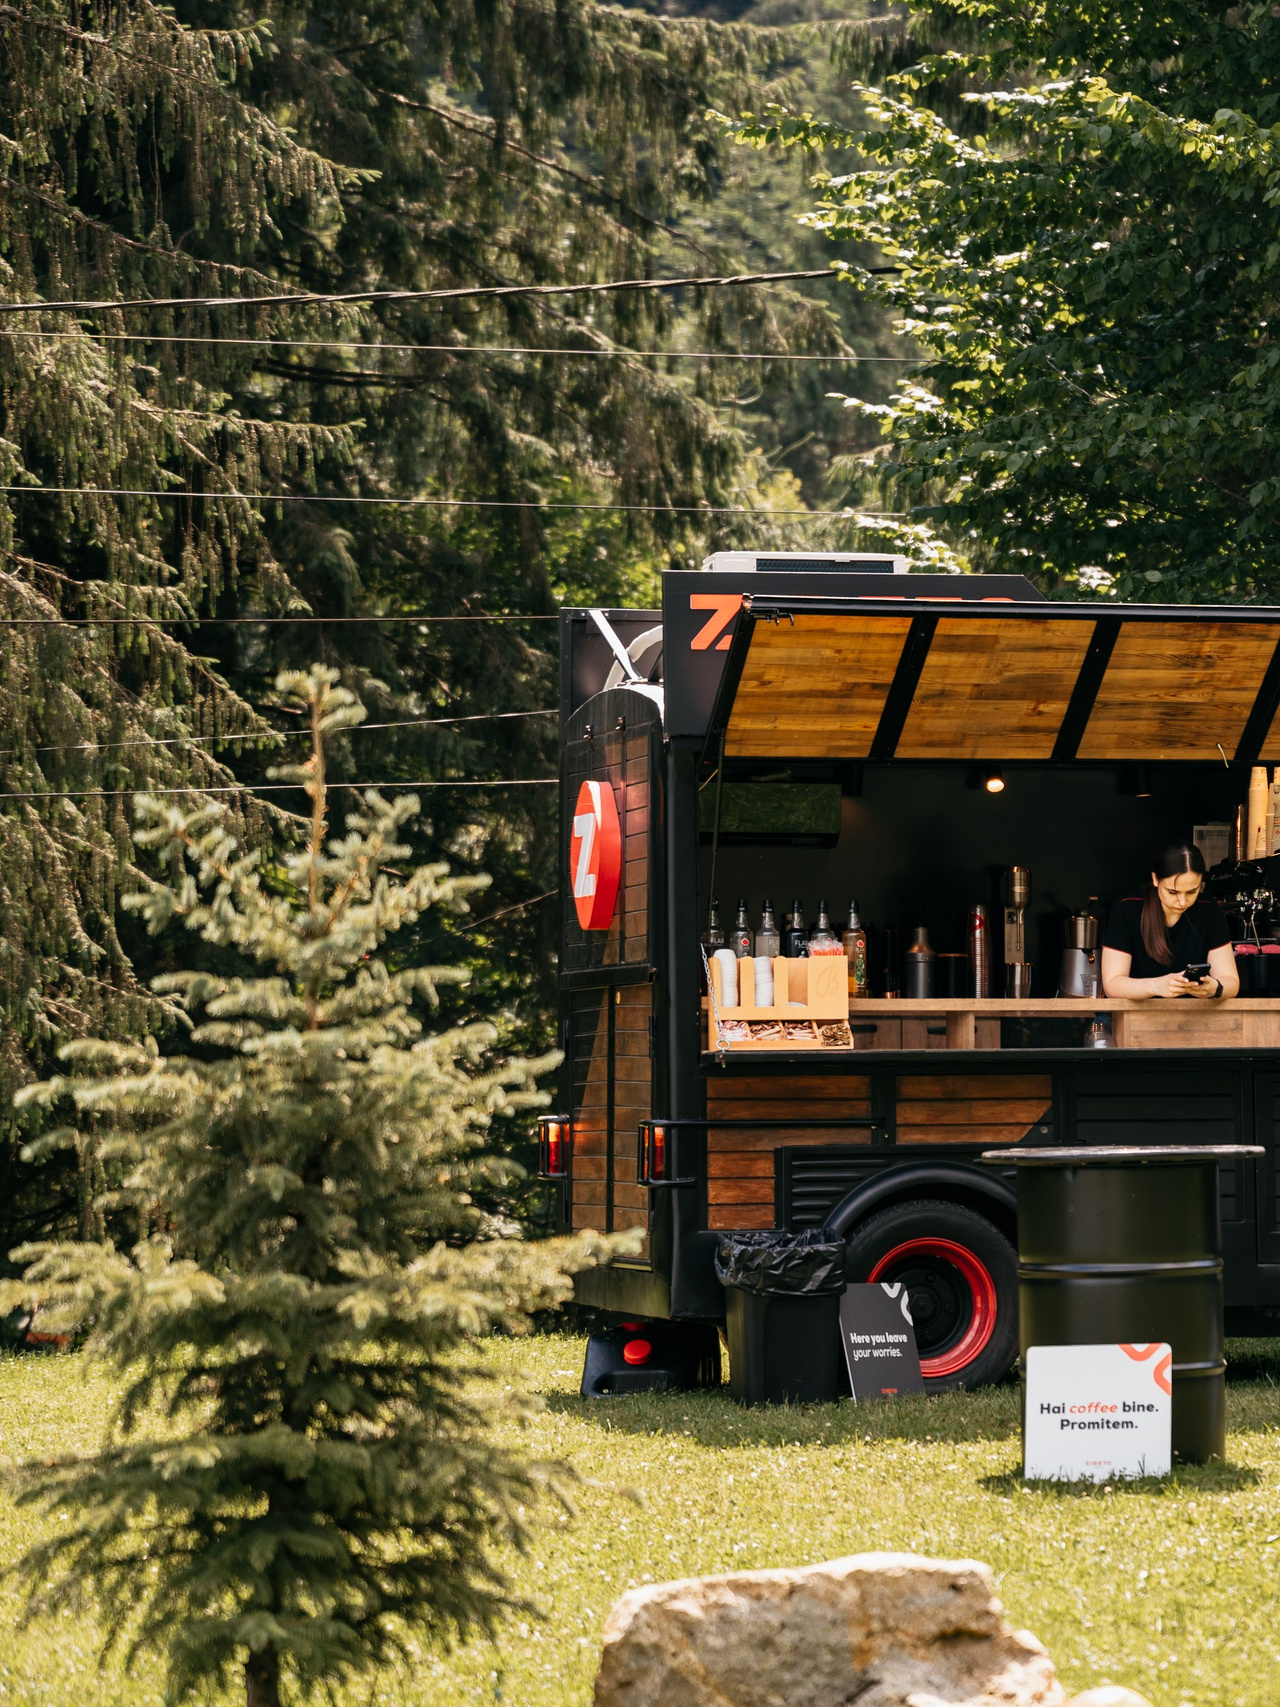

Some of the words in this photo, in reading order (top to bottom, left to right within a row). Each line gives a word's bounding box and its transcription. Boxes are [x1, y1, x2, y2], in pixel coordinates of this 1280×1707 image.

[574, 812, 596, 898] Z
[850, 1332, 870, 1344] Here
[870, 1335, 886, 1346] you
[885, 1332, 908, 1343] leave
[853, 1349, 871, 1361] your
[872, 1346, 903, 1358] worries.
[1040, 1402, 1065, 1414] Hai
[1069, 1402, 1118, 1414] coffee
[1122, 1401, 1159, 1413] bine.
[1060, 1418, 1138, 1430] Promitem.
